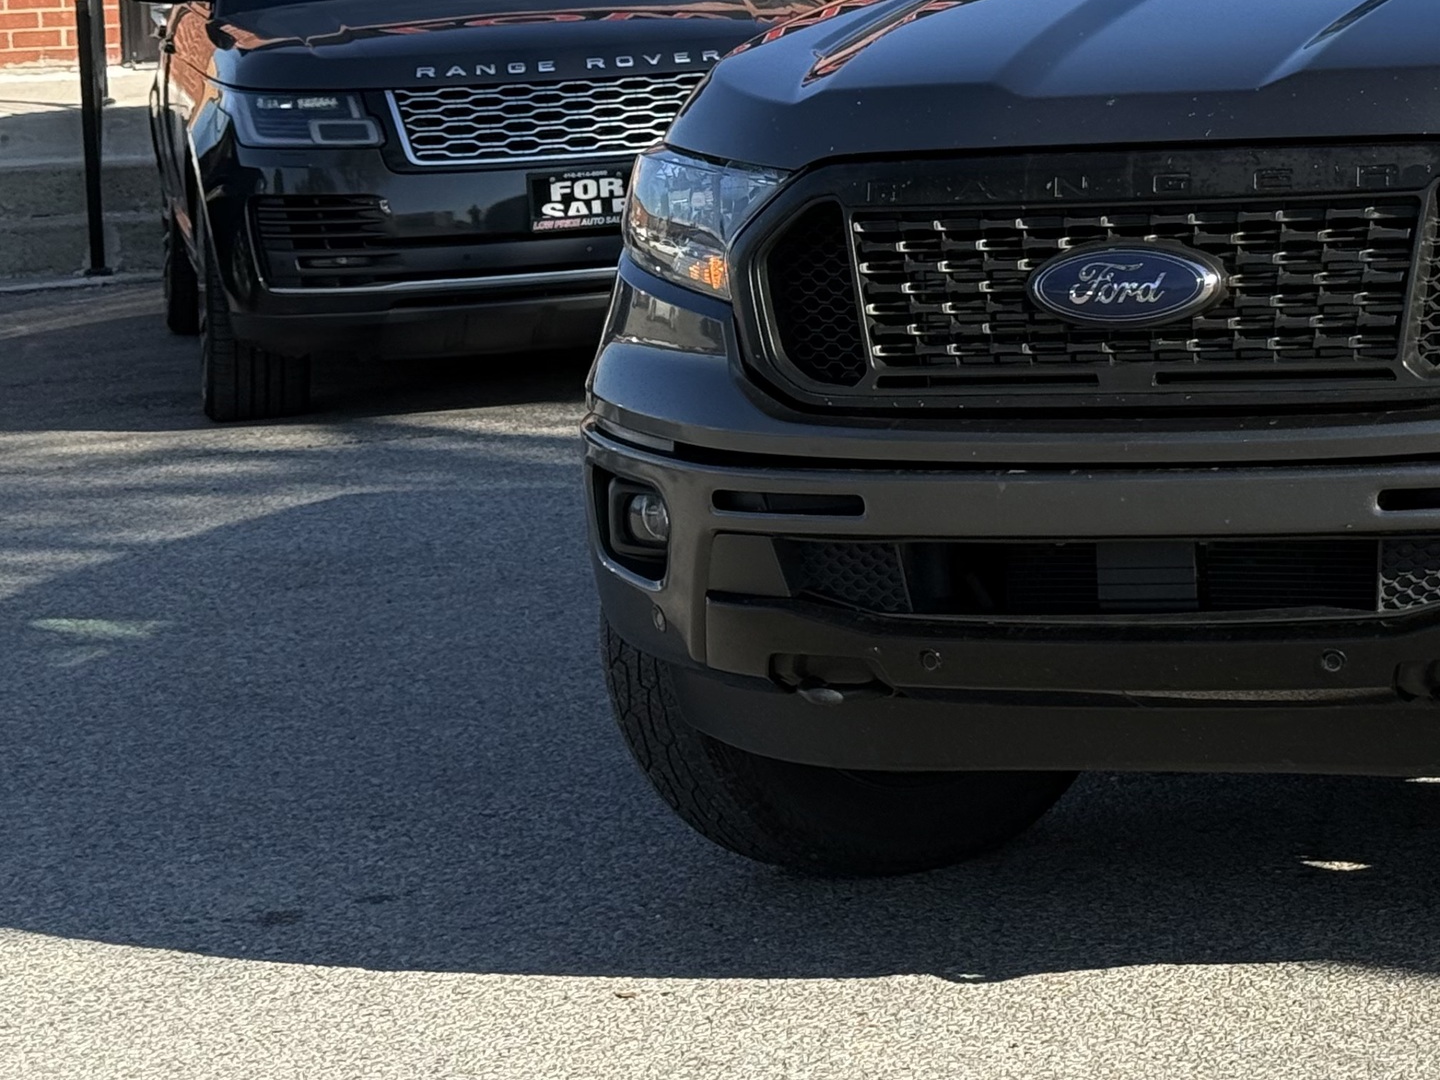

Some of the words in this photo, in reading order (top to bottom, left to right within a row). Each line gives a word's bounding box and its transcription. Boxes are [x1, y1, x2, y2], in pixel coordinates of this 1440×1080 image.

[416, 60, 556, 78] RANGE
[586, 49, 721, 69] ROVER
[549, 177, 625, 202] FOR
[865, 162, 1400, 204] RANGER
[1068, 261, 1165, 307] Ford
